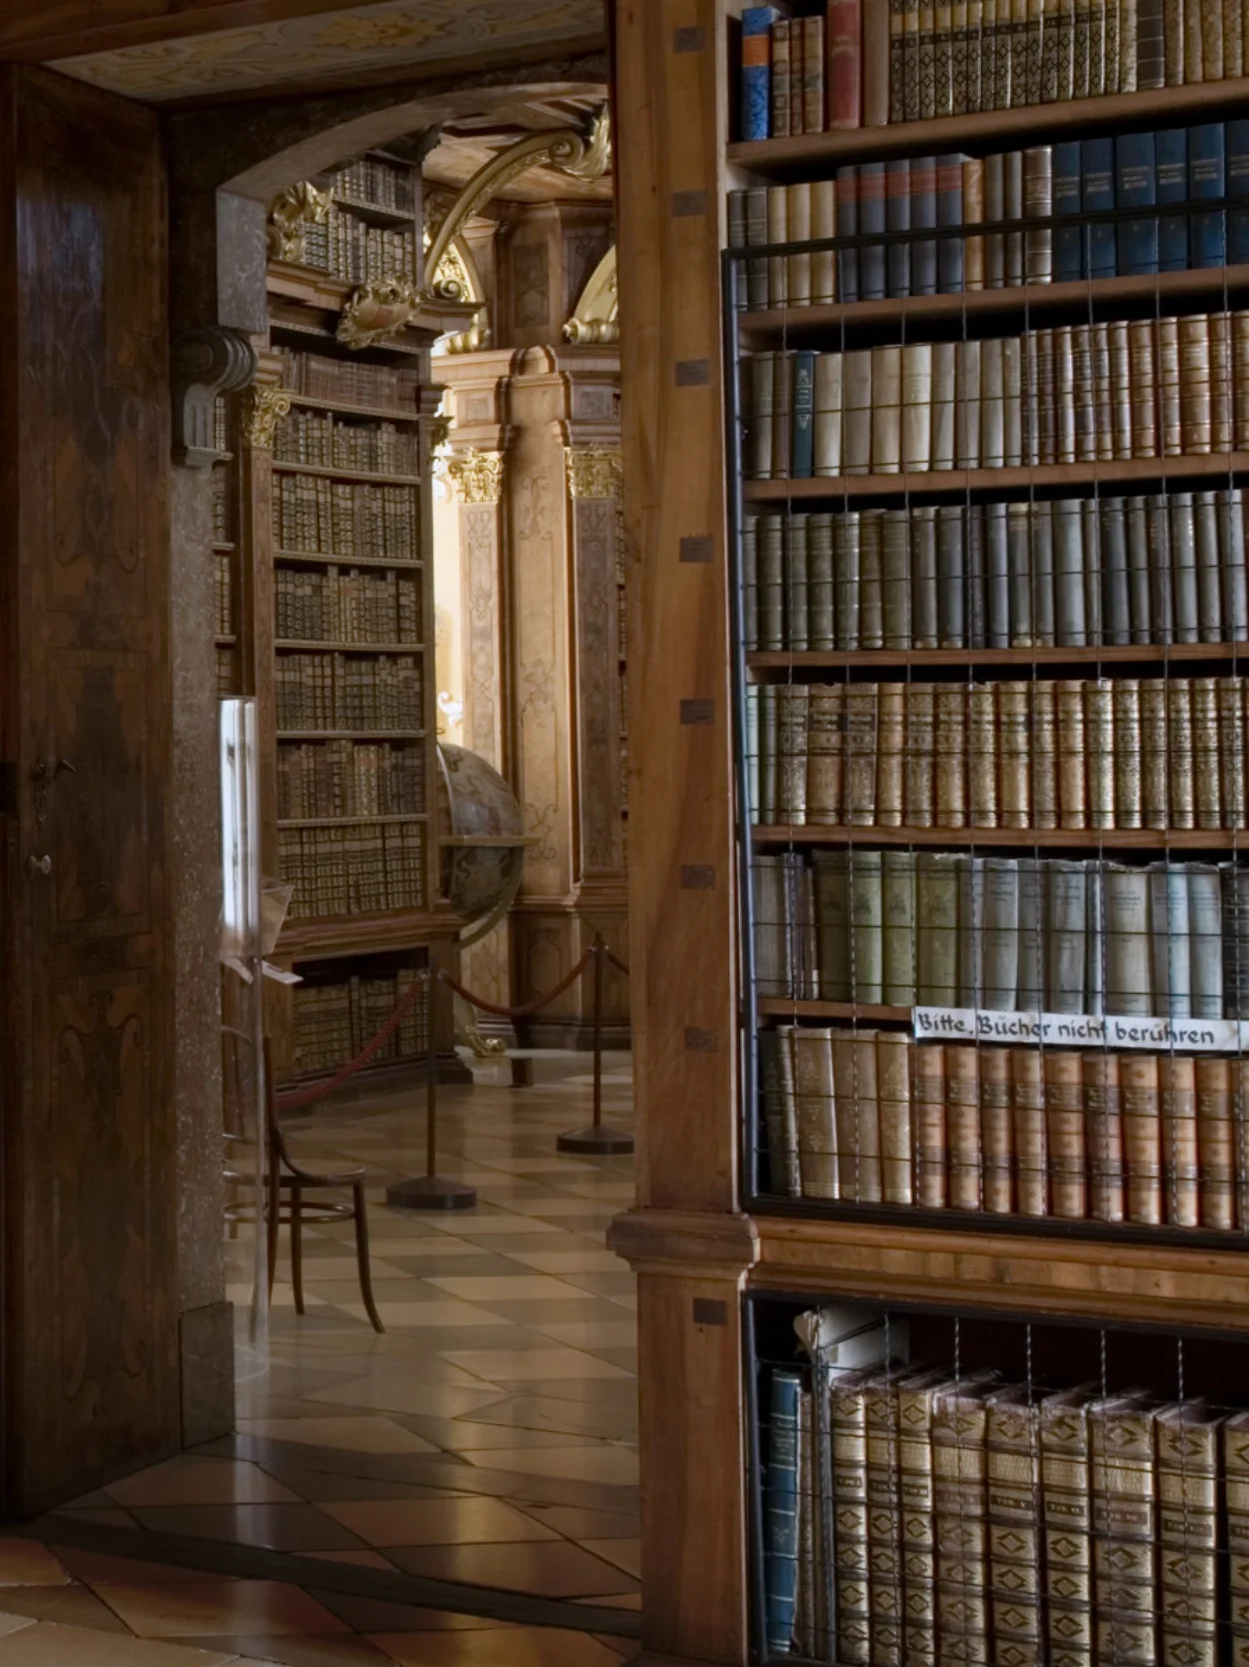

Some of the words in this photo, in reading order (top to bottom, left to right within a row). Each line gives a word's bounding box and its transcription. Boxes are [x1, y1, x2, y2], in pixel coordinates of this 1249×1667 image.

[977, 1015, 1051, 1037] Bücher
[1058, 1019, 1107, 1040] nicht
[1115, 1020, 1215, 1045] berühren
